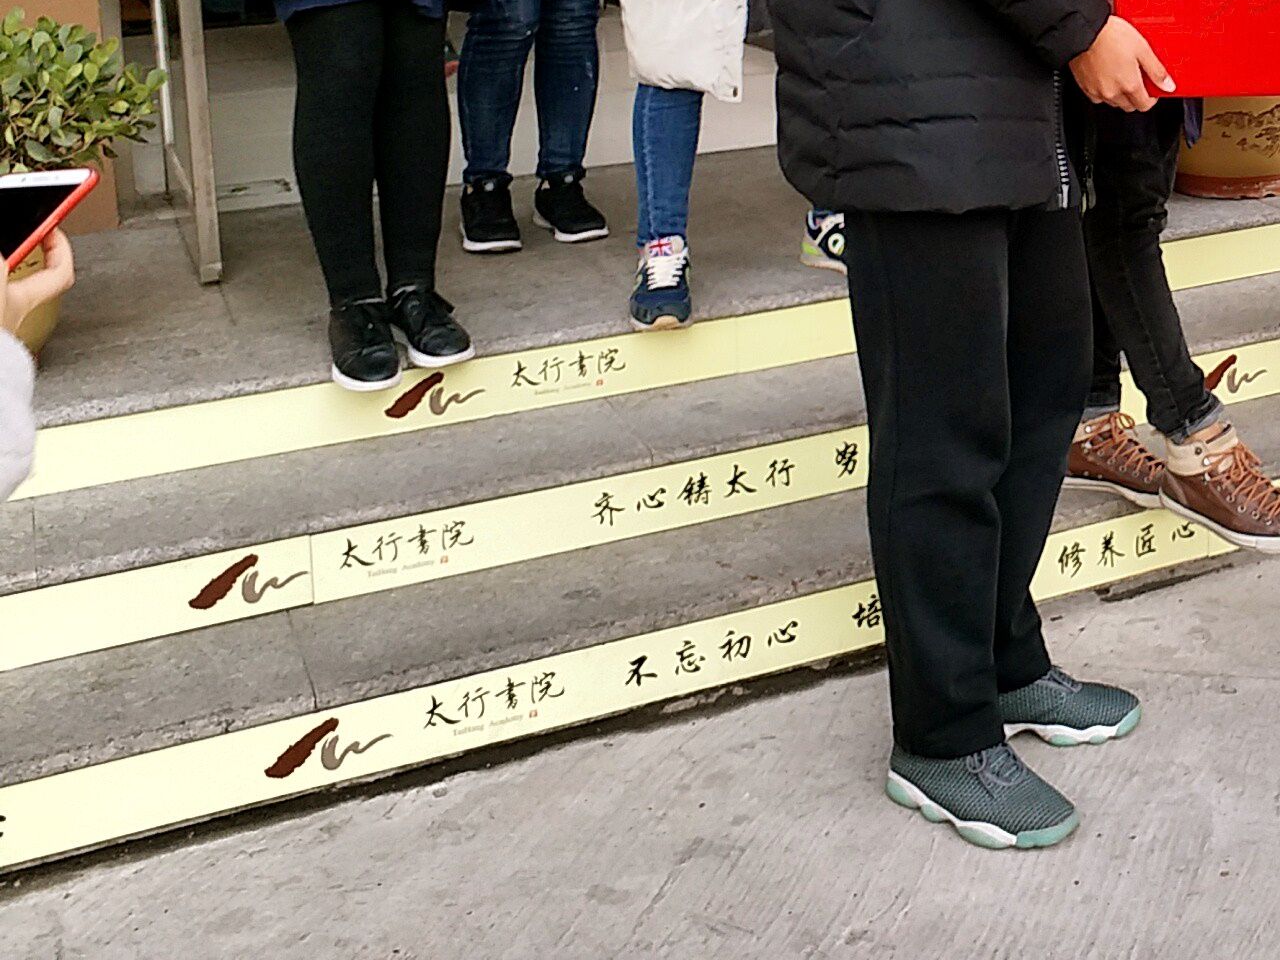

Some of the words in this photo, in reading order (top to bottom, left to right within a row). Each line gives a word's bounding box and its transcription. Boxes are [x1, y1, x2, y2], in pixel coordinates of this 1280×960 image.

[625, 620, 799, 688] 不忘初心
[1058, 521, 1196, 578] 修养匠心
